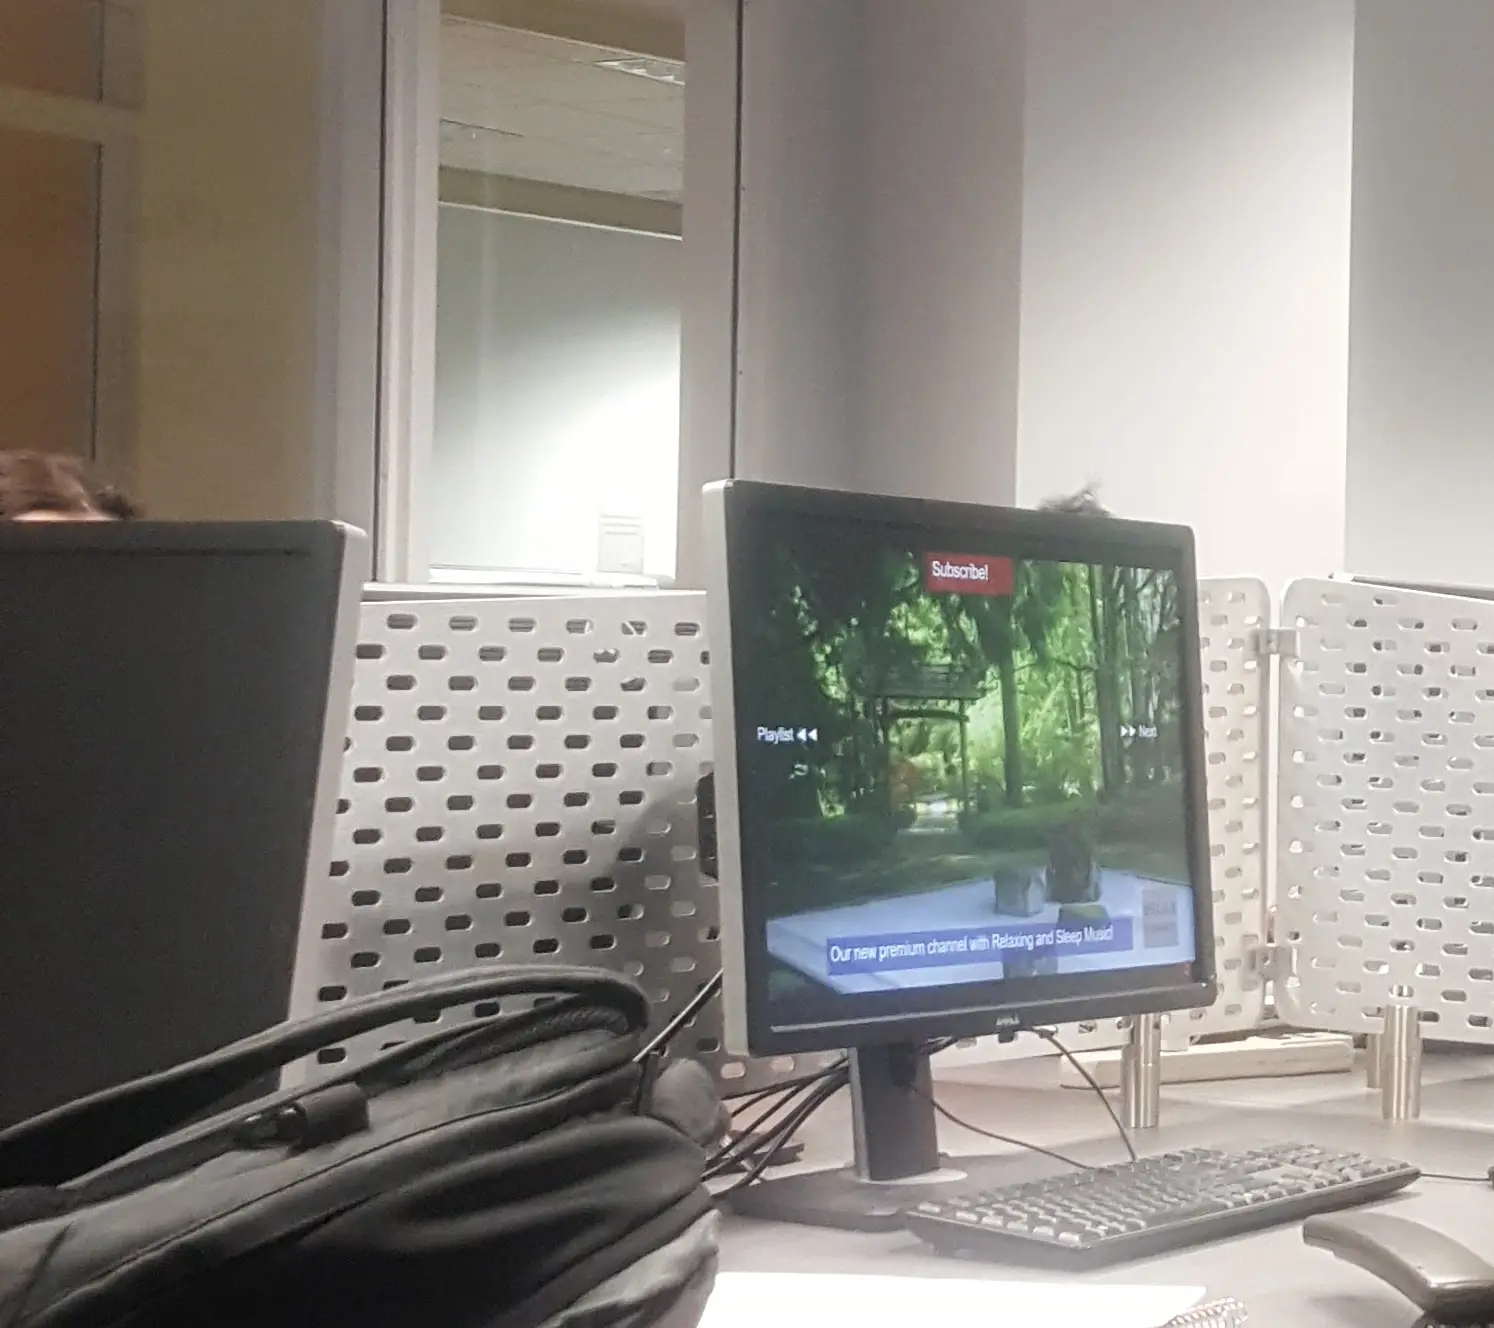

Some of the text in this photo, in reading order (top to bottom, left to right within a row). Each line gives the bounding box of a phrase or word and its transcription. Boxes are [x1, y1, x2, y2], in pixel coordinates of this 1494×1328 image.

[931, 560, 989, 582] Subscribe!
[756, 726, 795, 745] Playlist
[830, 945, 851, 963] Our
[853, 947, 877, 961] new
[878, 940, 926, 963] premium
[927, 936, 969, 955] channel
[969, 935, 990, 952] with
[991, 931, 1035, 951] Relaxing
[1035, 929, 1055, 947] and
[1055, 928, 1083, 948] Sleep
